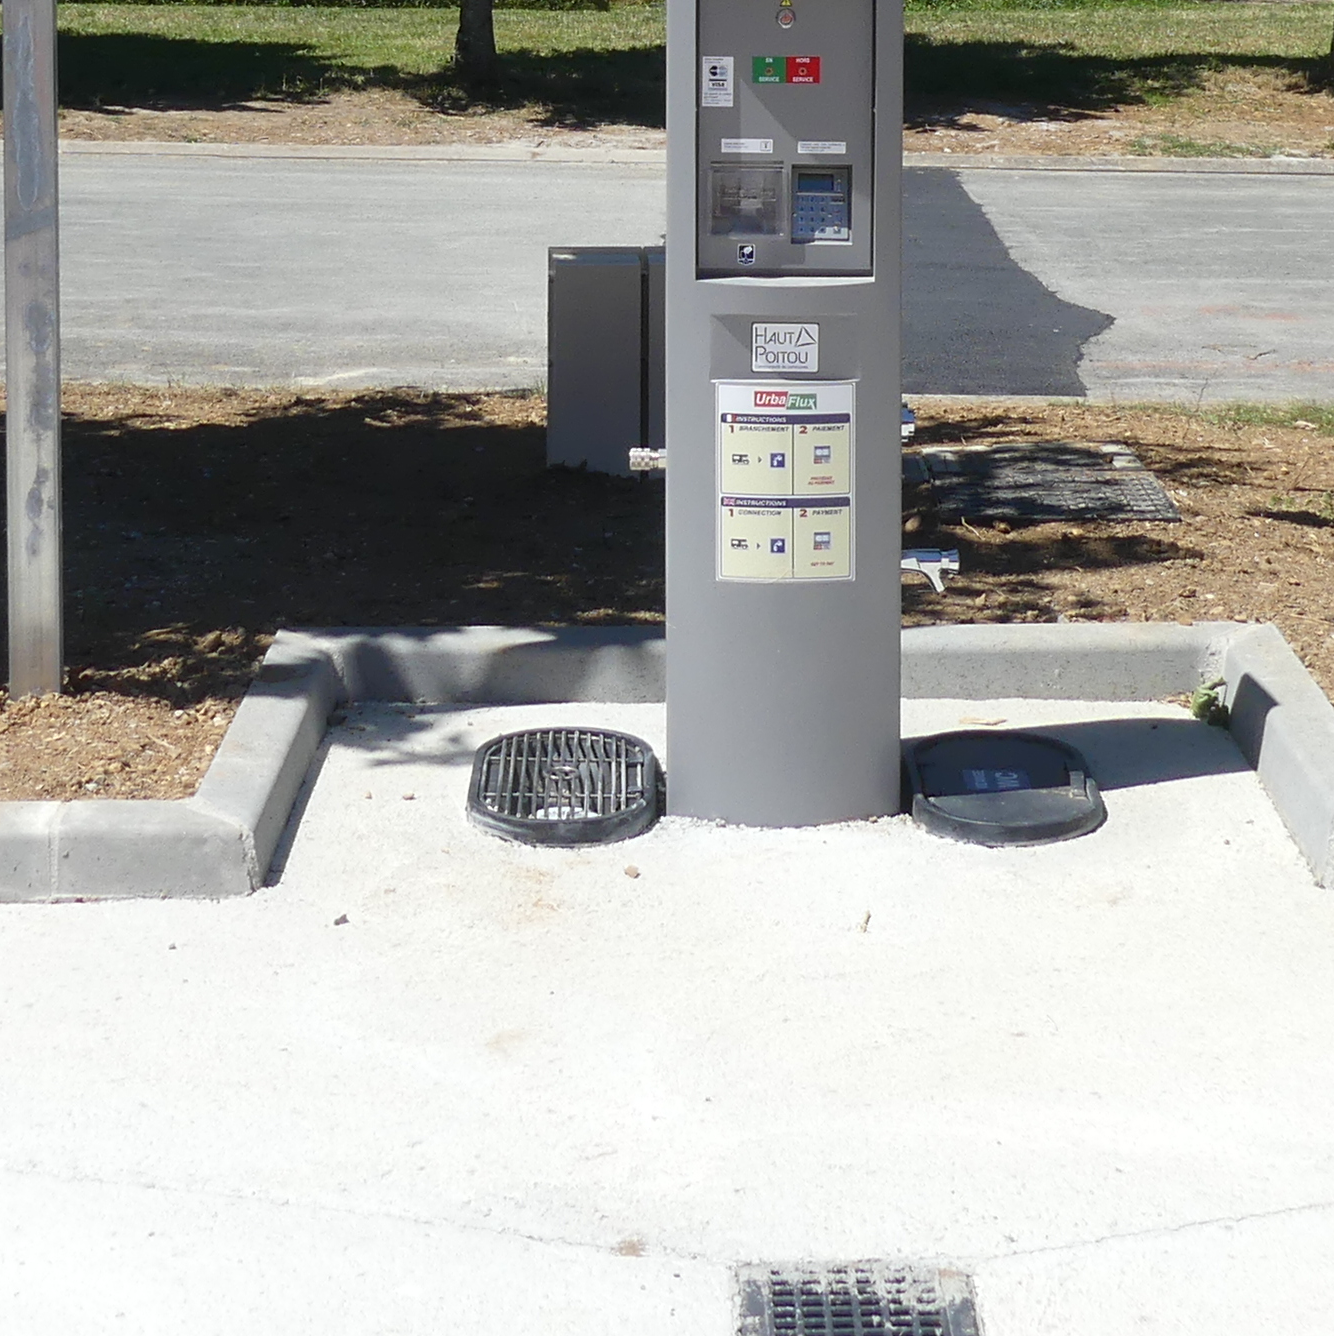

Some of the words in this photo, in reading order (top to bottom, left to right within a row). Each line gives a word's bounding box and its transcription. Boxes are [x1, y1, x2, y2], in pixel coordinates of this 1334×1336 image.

[755, 326, 795, 344] HAUT
[755, 345, 808, 364] POITOU
[756, 393, 786, 405] Urba
[788, 396, 816, 409] Flux
[729, 425, 734, 433] 1
[799, 426, 808, 434] 2
[729, 509, 734, 517] 1
[800, 509, 808, 517] 2
